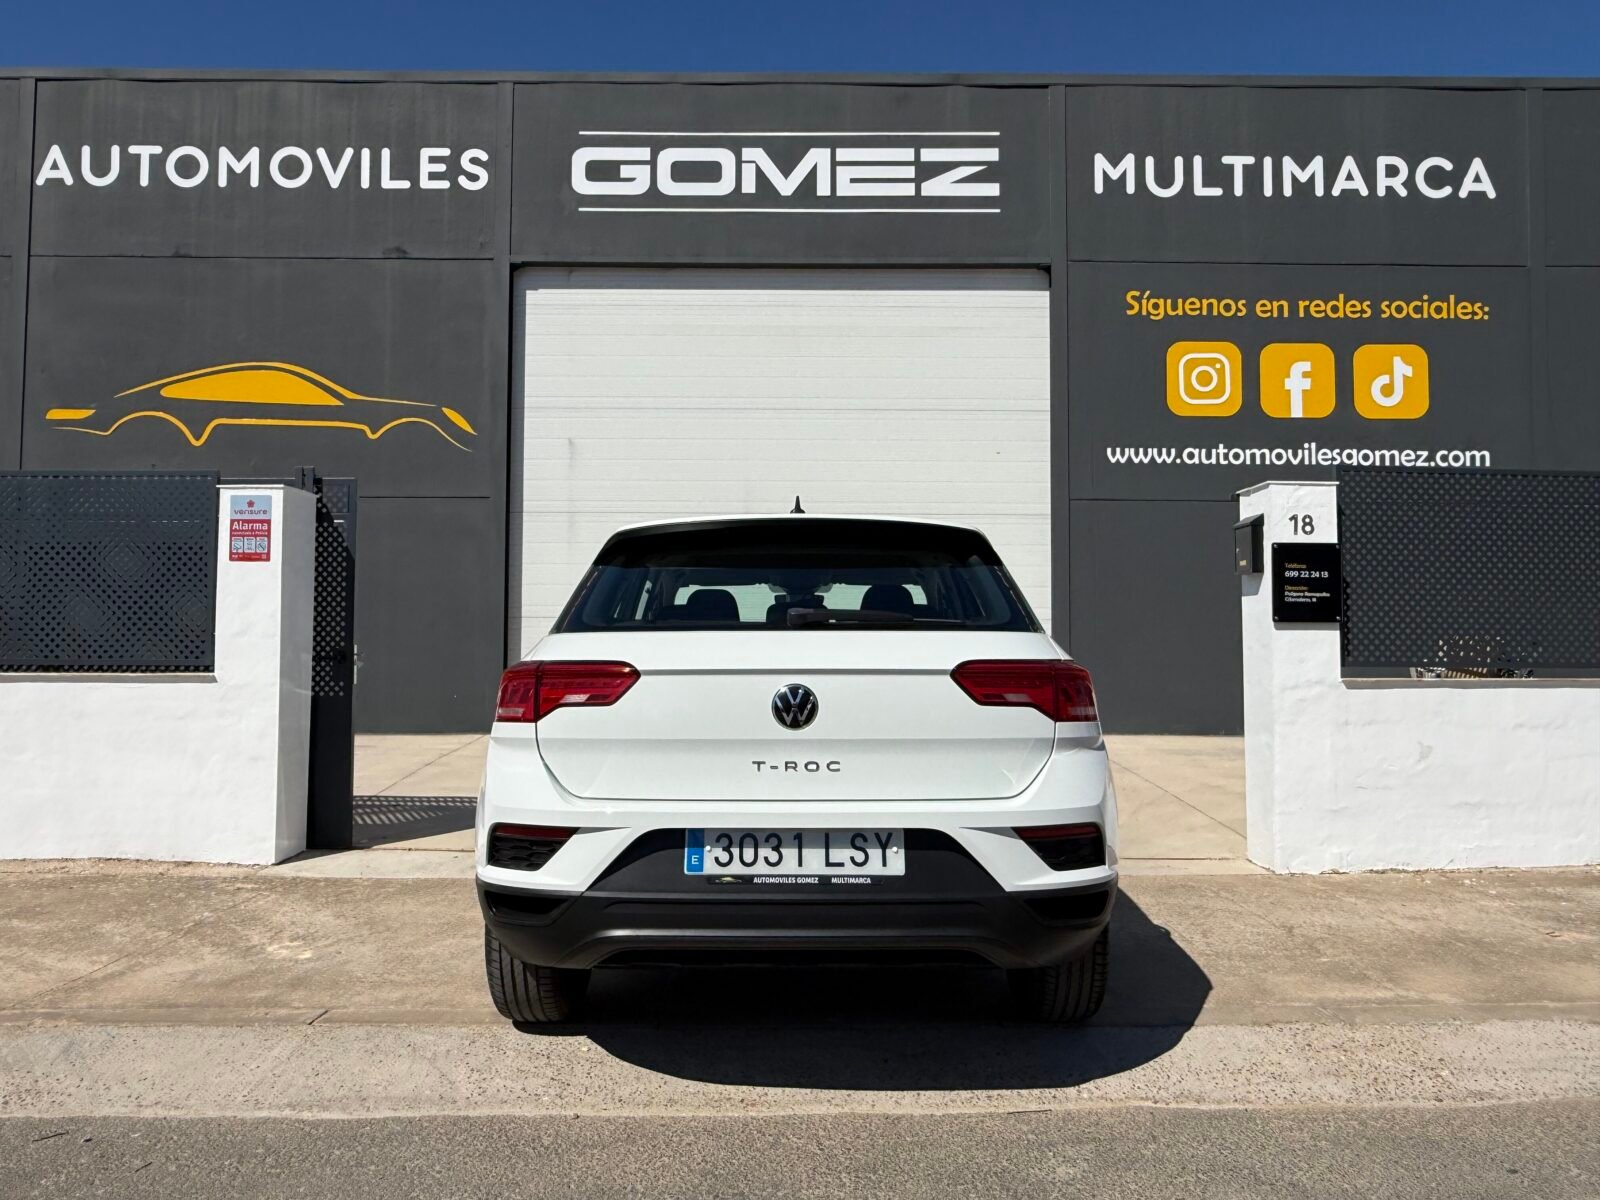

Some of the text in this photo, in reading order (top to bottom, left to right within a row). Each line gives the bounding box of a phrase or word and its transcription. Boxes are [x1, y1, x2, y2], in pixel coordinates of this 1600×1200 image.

[35, 144, 490, 191] AUTOMOVILES
[571, 146, 1001, 197] GOMEZ
[1093, 152, 1497, 200] MULTIMARCA
[1125, 290, 1491, 321] Síguenos en redes sociales:
[232, 520, 269, 530] Alarma
[1288, 514, 1315, 536] 18
[751, 760, 842, 773] T-ROC
[691, 855, 700, 865] E
[714, 831, 894, 868] 3031 LSY
[753, 876, 819, 884] AUTOMOVILES GOMEZ
